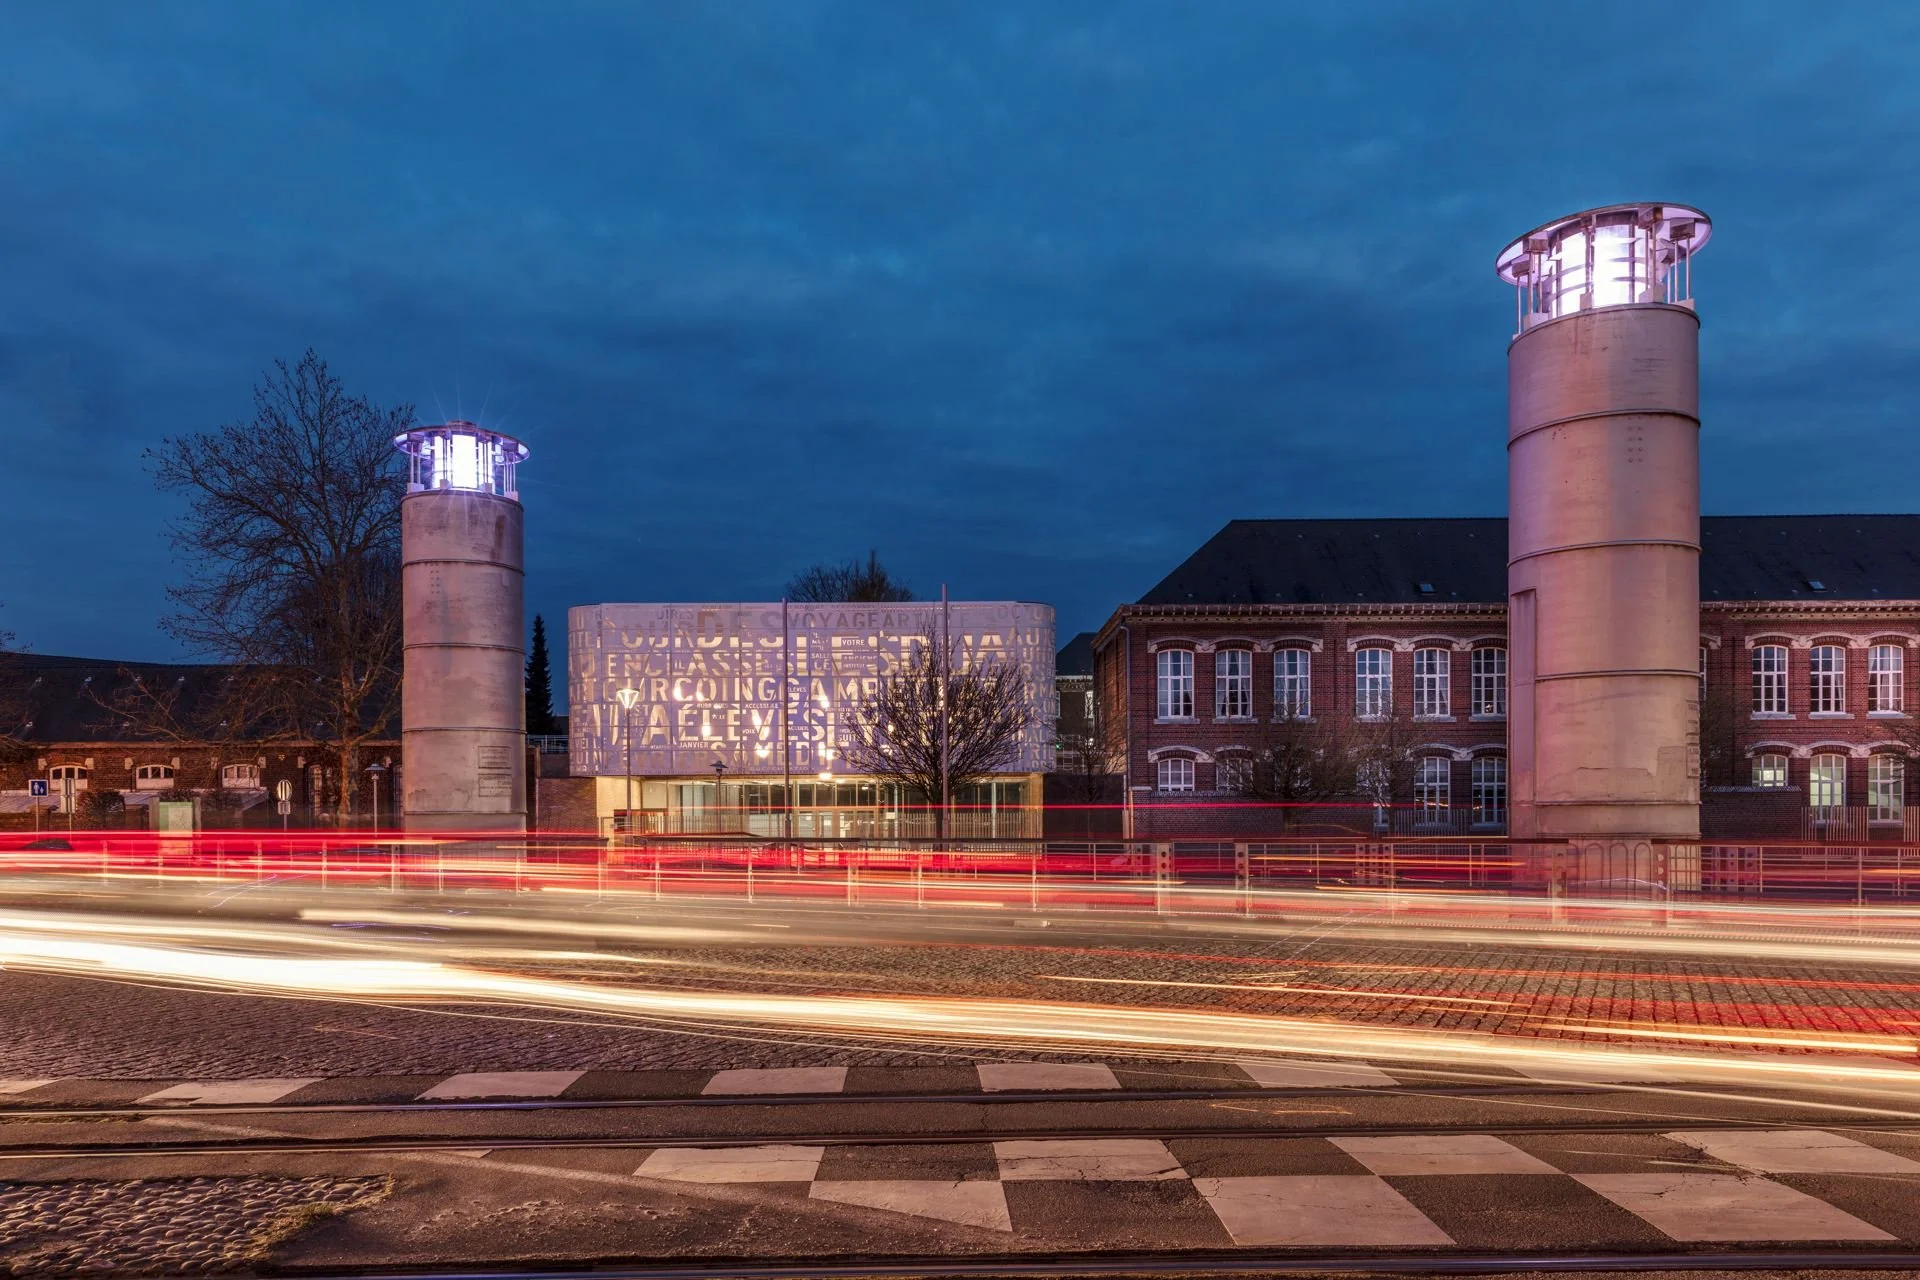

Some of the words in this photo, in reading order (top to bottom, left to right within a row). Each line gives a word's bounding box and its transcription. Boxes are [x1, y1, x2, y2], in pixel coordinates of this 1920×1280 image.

[841, 639, 865, 647] VOTRE
[677, 703, 826, 742] ÉLÈVES
[679, 740, 709, 750] JANVIER
